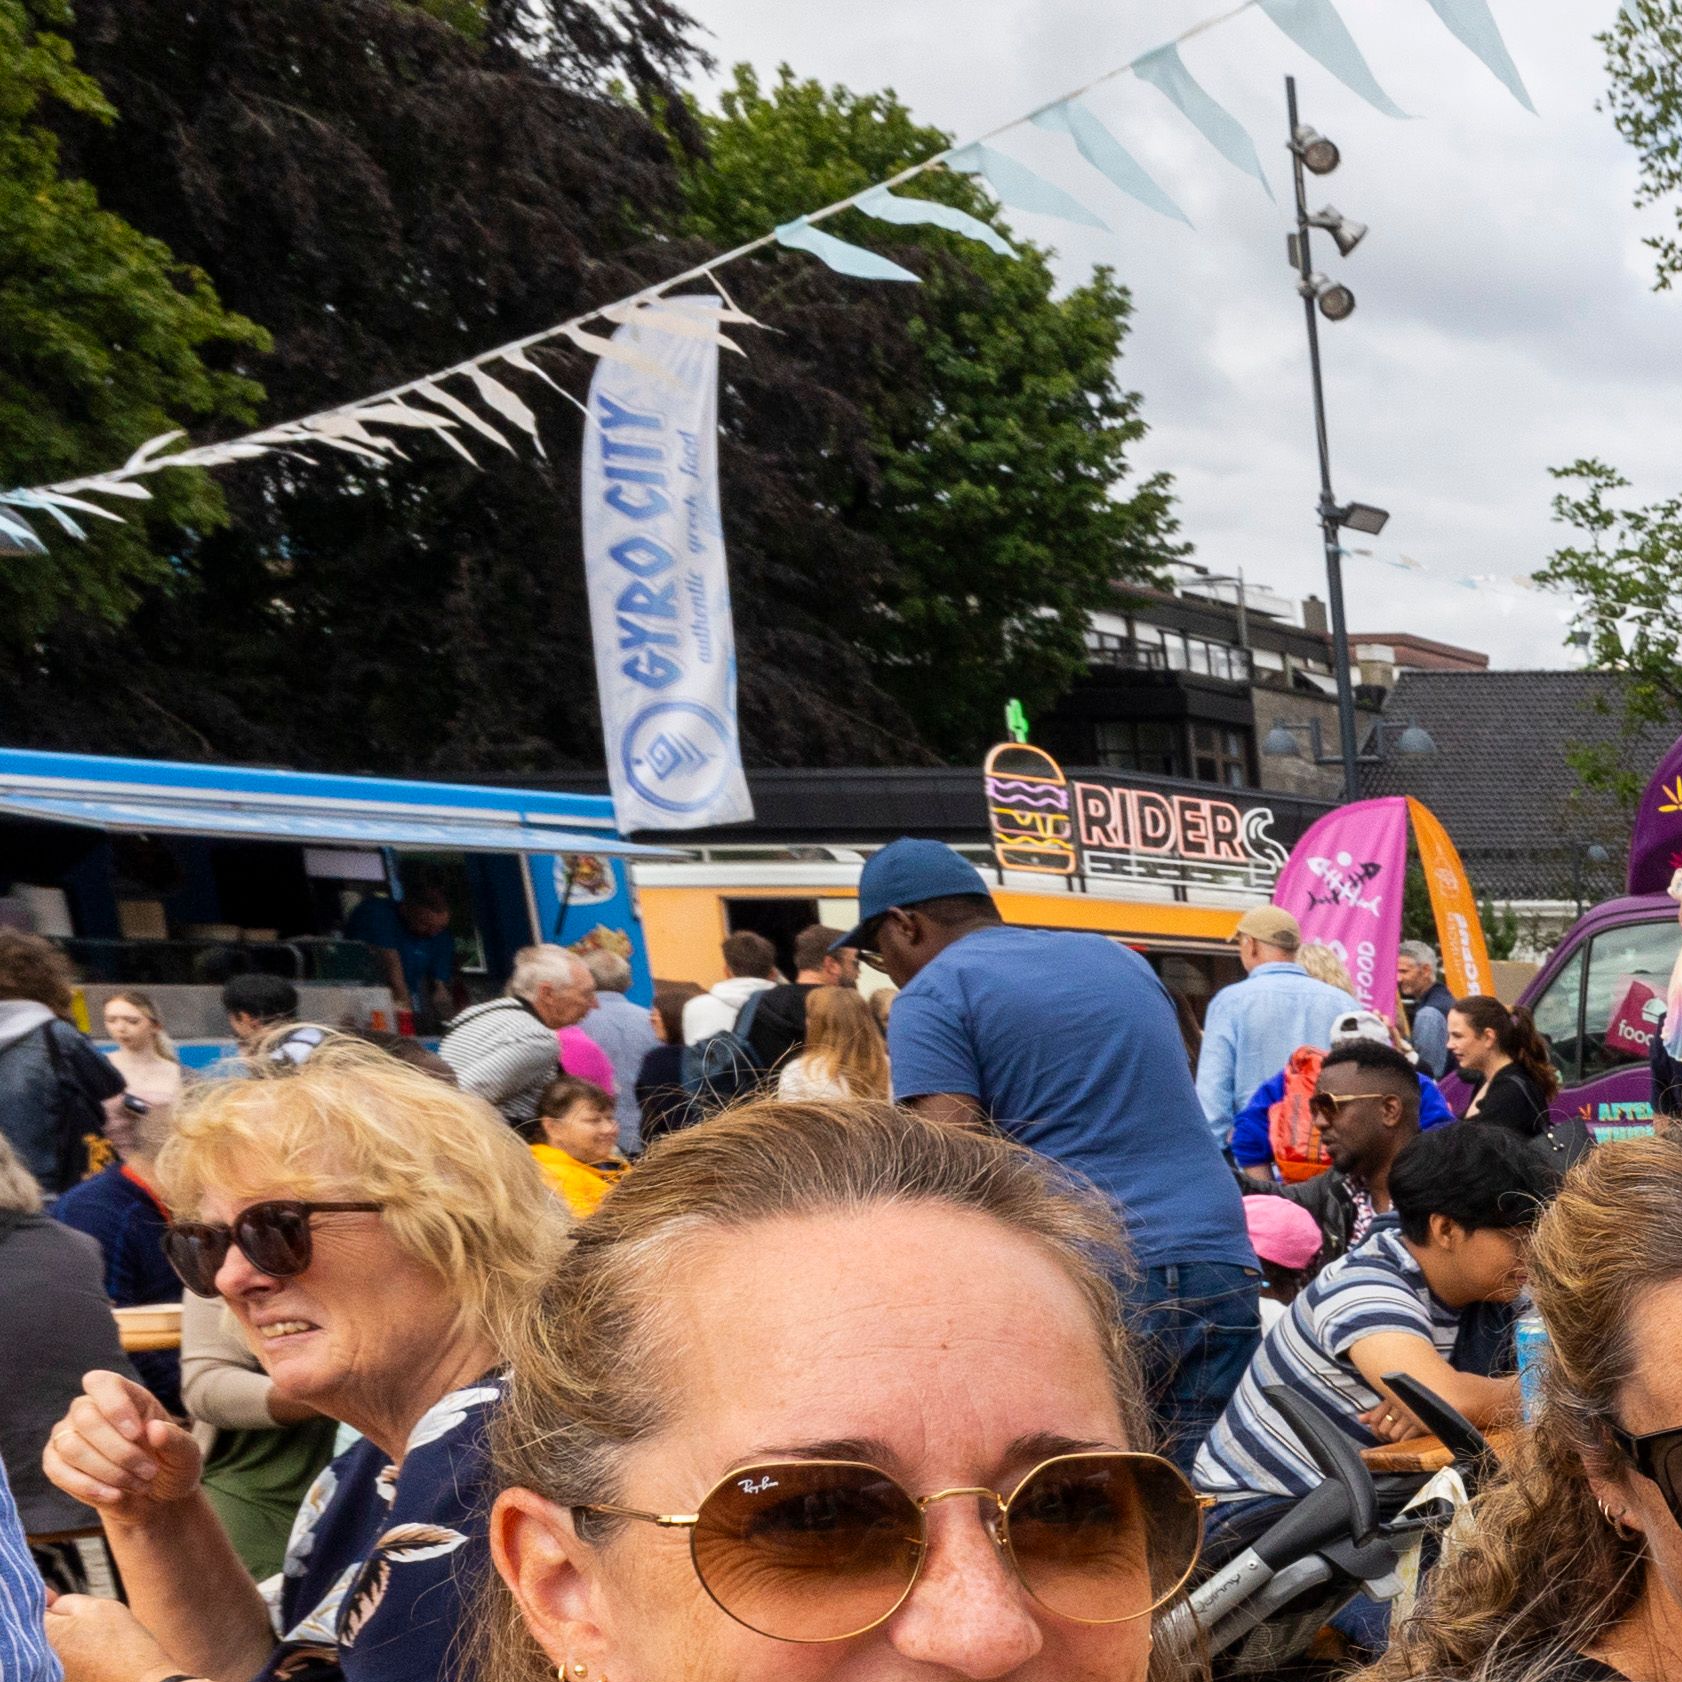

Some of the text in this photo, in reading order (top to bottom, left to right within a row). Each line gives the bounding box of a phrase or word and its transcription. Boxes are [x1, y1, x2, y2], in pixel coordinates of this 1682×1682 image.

[678, 430, 700, 479] food
[597, 393, 684, 690] GYRO CITY
[1074, 782, 1290, 873] RIDERS
